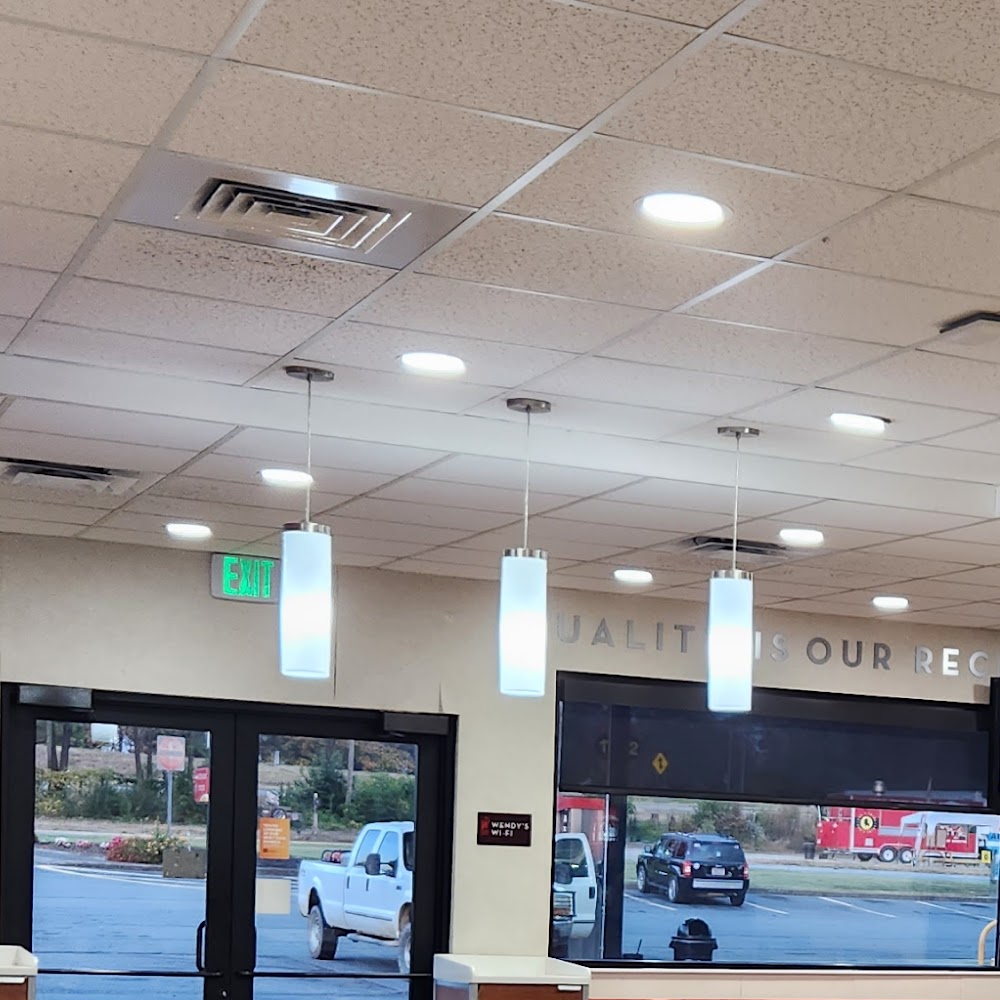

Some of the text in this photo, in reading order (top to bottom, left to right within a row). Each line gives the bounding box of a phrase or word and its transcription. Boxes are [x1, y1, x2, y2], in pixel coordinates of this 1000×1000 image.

[223, 556, 274, 599] EXIT
[556, 613, 696, 654] UALIT
[753, 630, 790, 663] IS
[805, 636, 893, 671] OUR
[491, 821, 530, 831] WENDY'S
[491, 829, 514, 838] WI-FI
